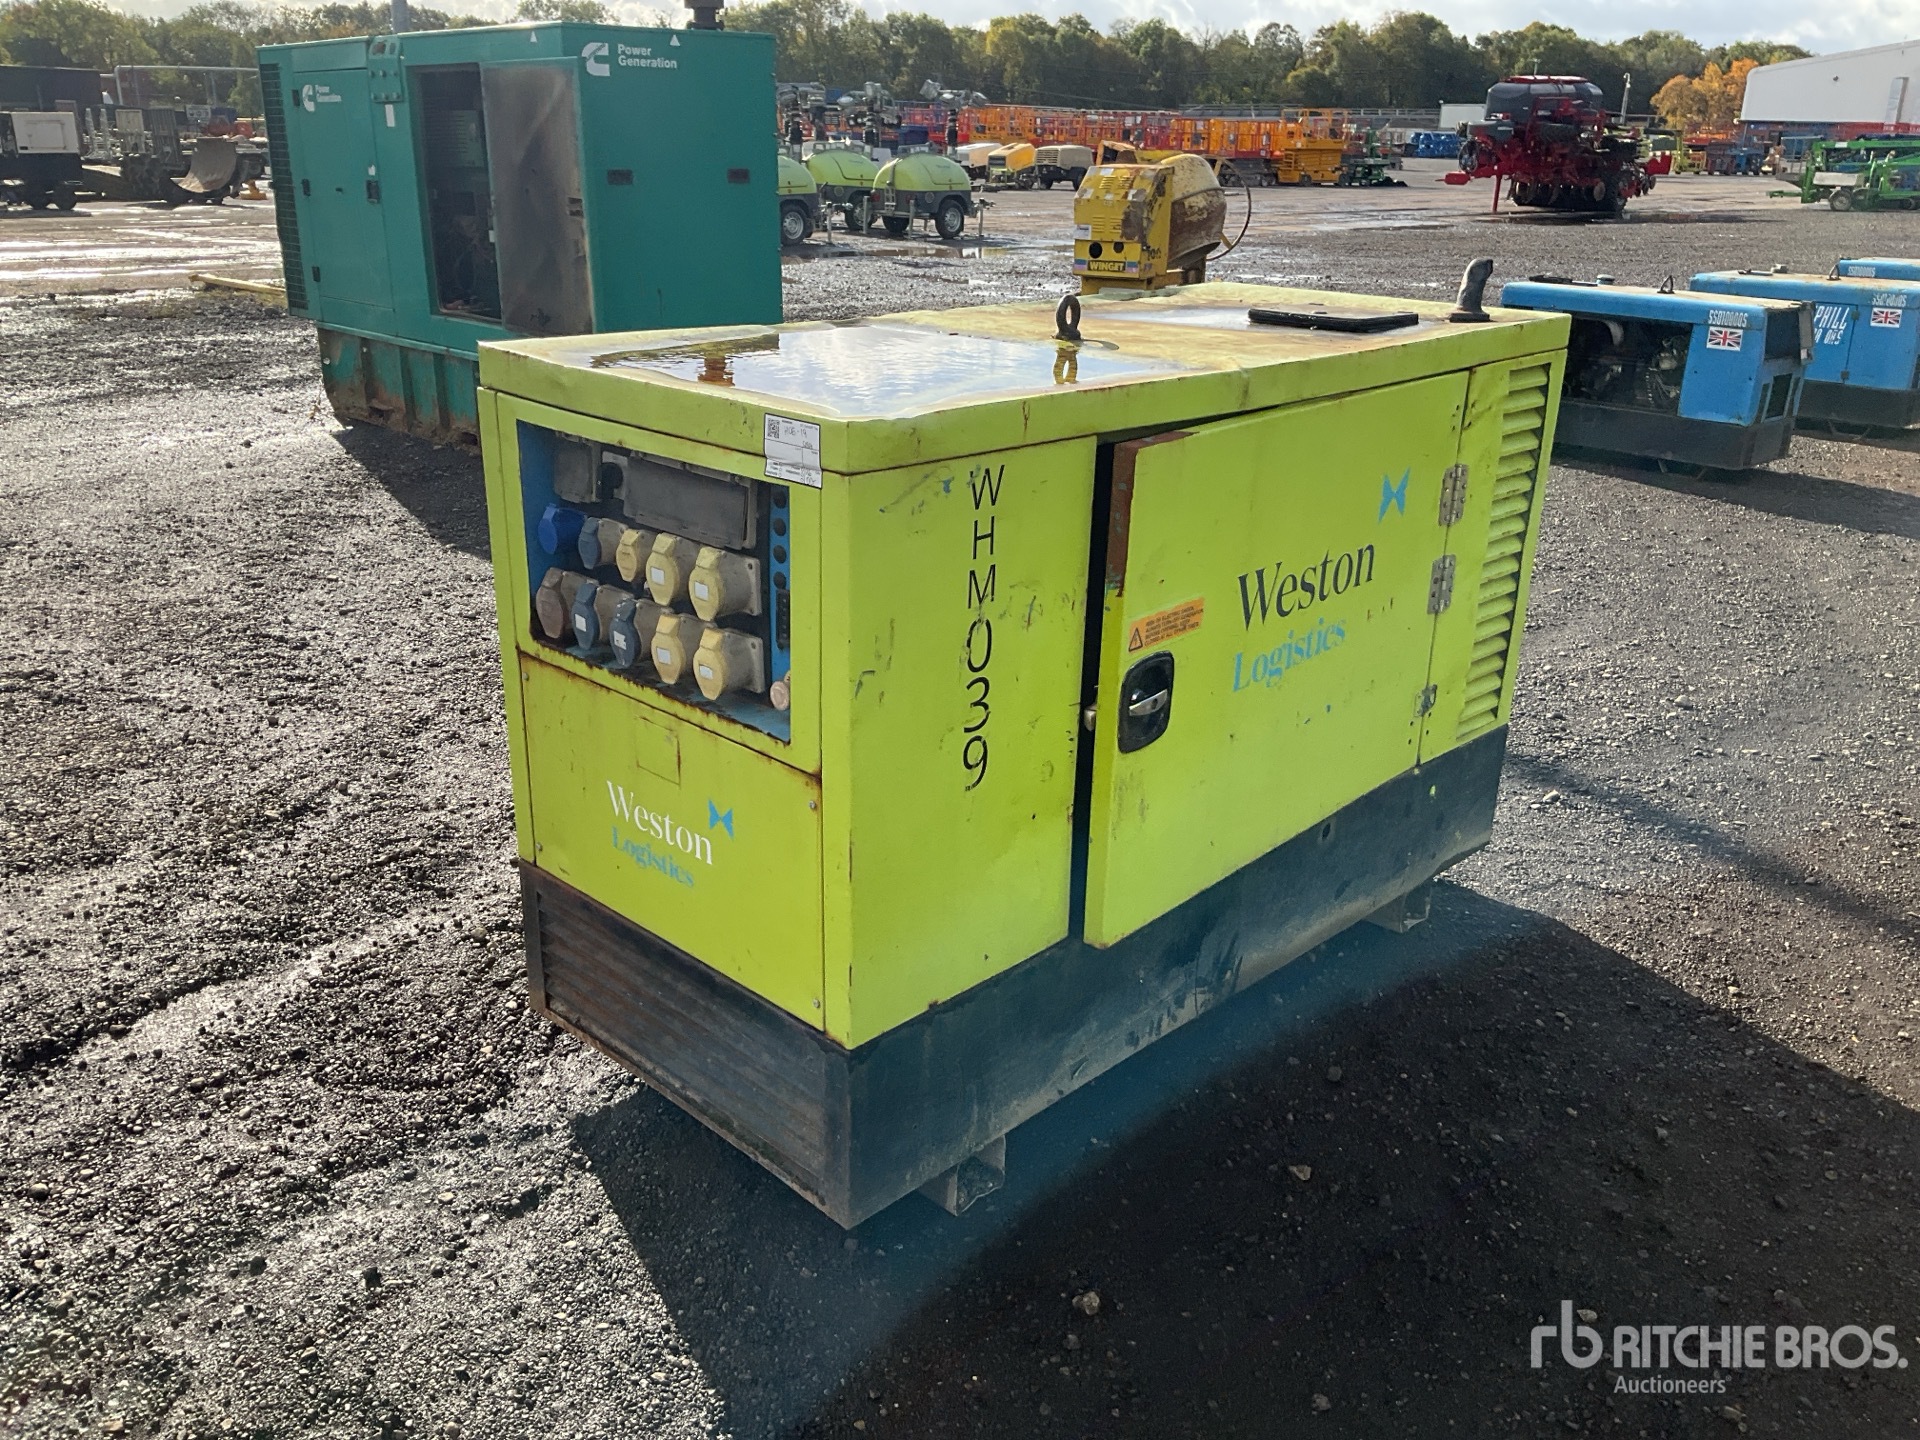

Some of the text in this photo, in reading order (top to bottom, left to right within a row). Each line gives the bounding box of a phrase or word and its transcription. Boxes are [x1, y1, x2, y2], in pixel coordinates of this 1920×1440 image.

[618, 44, 651, 56] Power
[618, 55, 678, 69] Generation
[1089, 261, 1124, 271] WINGET
[1813, 305, 1850, 329] PHILL
[1237, 543, 1375, 632] Weston
[1232, 617, 1347, 692] Logistics
[606, 780, 713, 865] Weston
